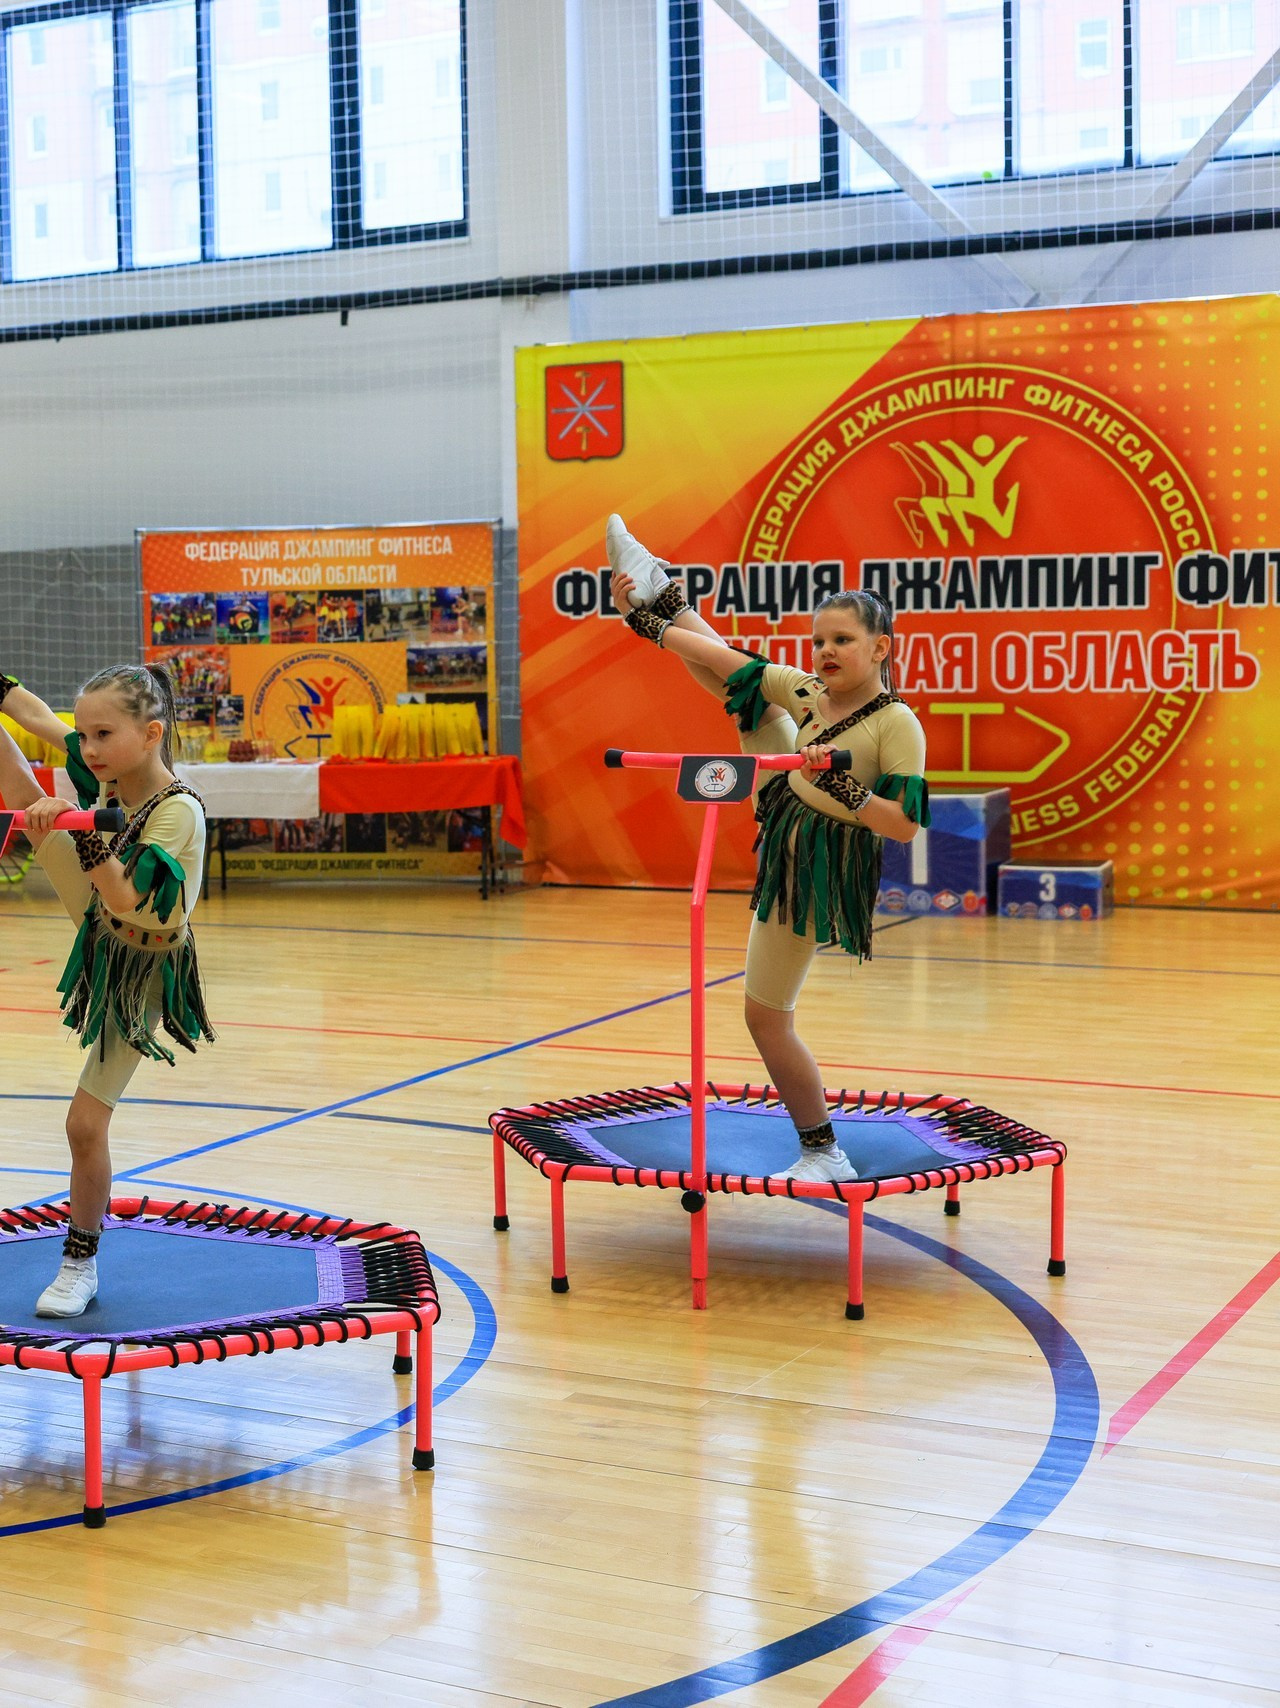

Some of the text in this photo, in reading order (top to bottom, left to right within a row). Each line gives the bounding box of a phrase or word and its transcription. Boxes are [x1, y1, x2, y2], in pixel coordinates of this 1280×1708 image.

[752, 377, 1202, 562] ДЕРАЦИЯ ДЖАМПИНГ ФИТНЕСА РОСС
[184, 535, 453, 562] ФЕДЕРАЦИЯ ДЖАМПИНГ ФИТНЕСА
[240, 563, 398, 587] ТУЛЬСКОЙ ОБЛАСТИ
[992, 630, 1260, 693] ОБЛАСТЬ
[1039, 872, 1057, 902] 3
